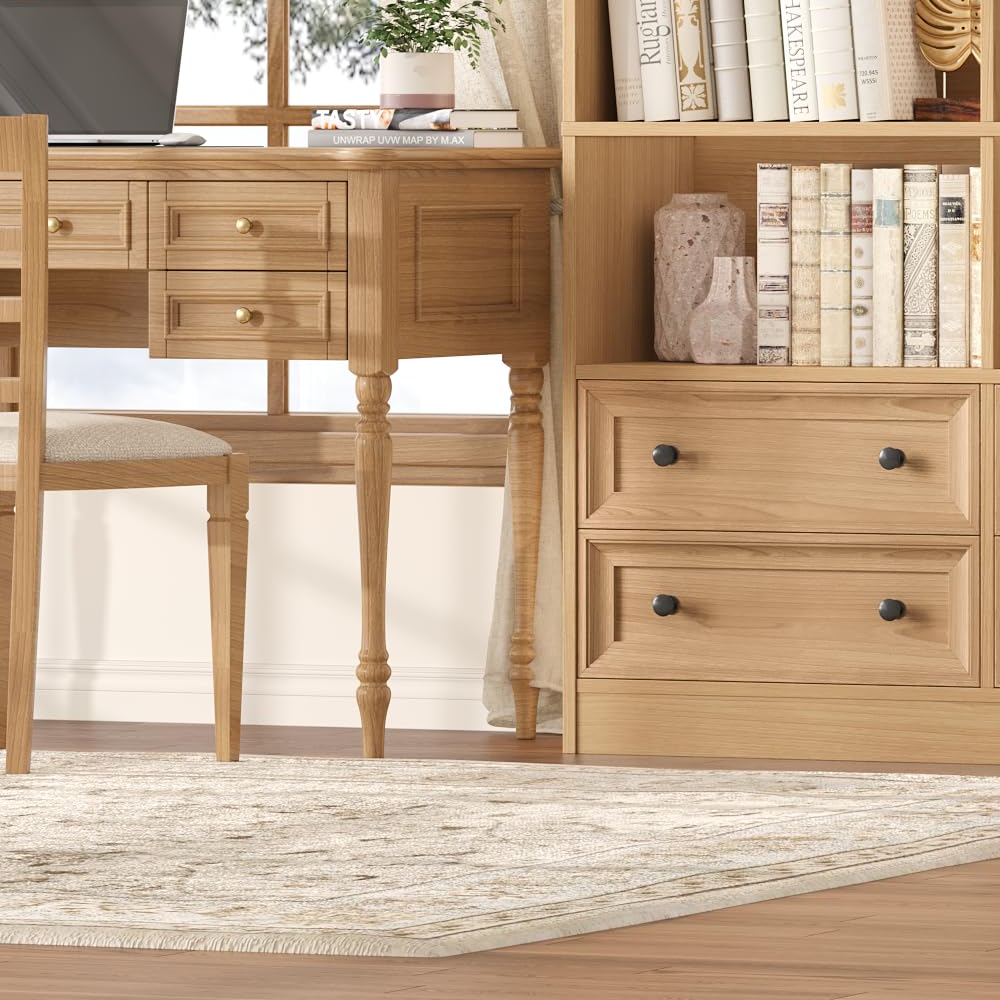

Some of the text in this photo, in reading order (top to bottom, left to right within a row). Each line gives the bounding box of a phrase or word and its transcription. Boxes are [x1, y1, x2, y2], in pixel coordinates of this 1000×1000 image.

[316, 109, 384, 130] TASTY
[333, 136, 375, 144] UNWRAP
[378, 136, 400, 144] UVW
[402, 136, 423, 144] MAP
[425, 136, 438, 144] BY
[904, 208, 935, 219] POEMS
